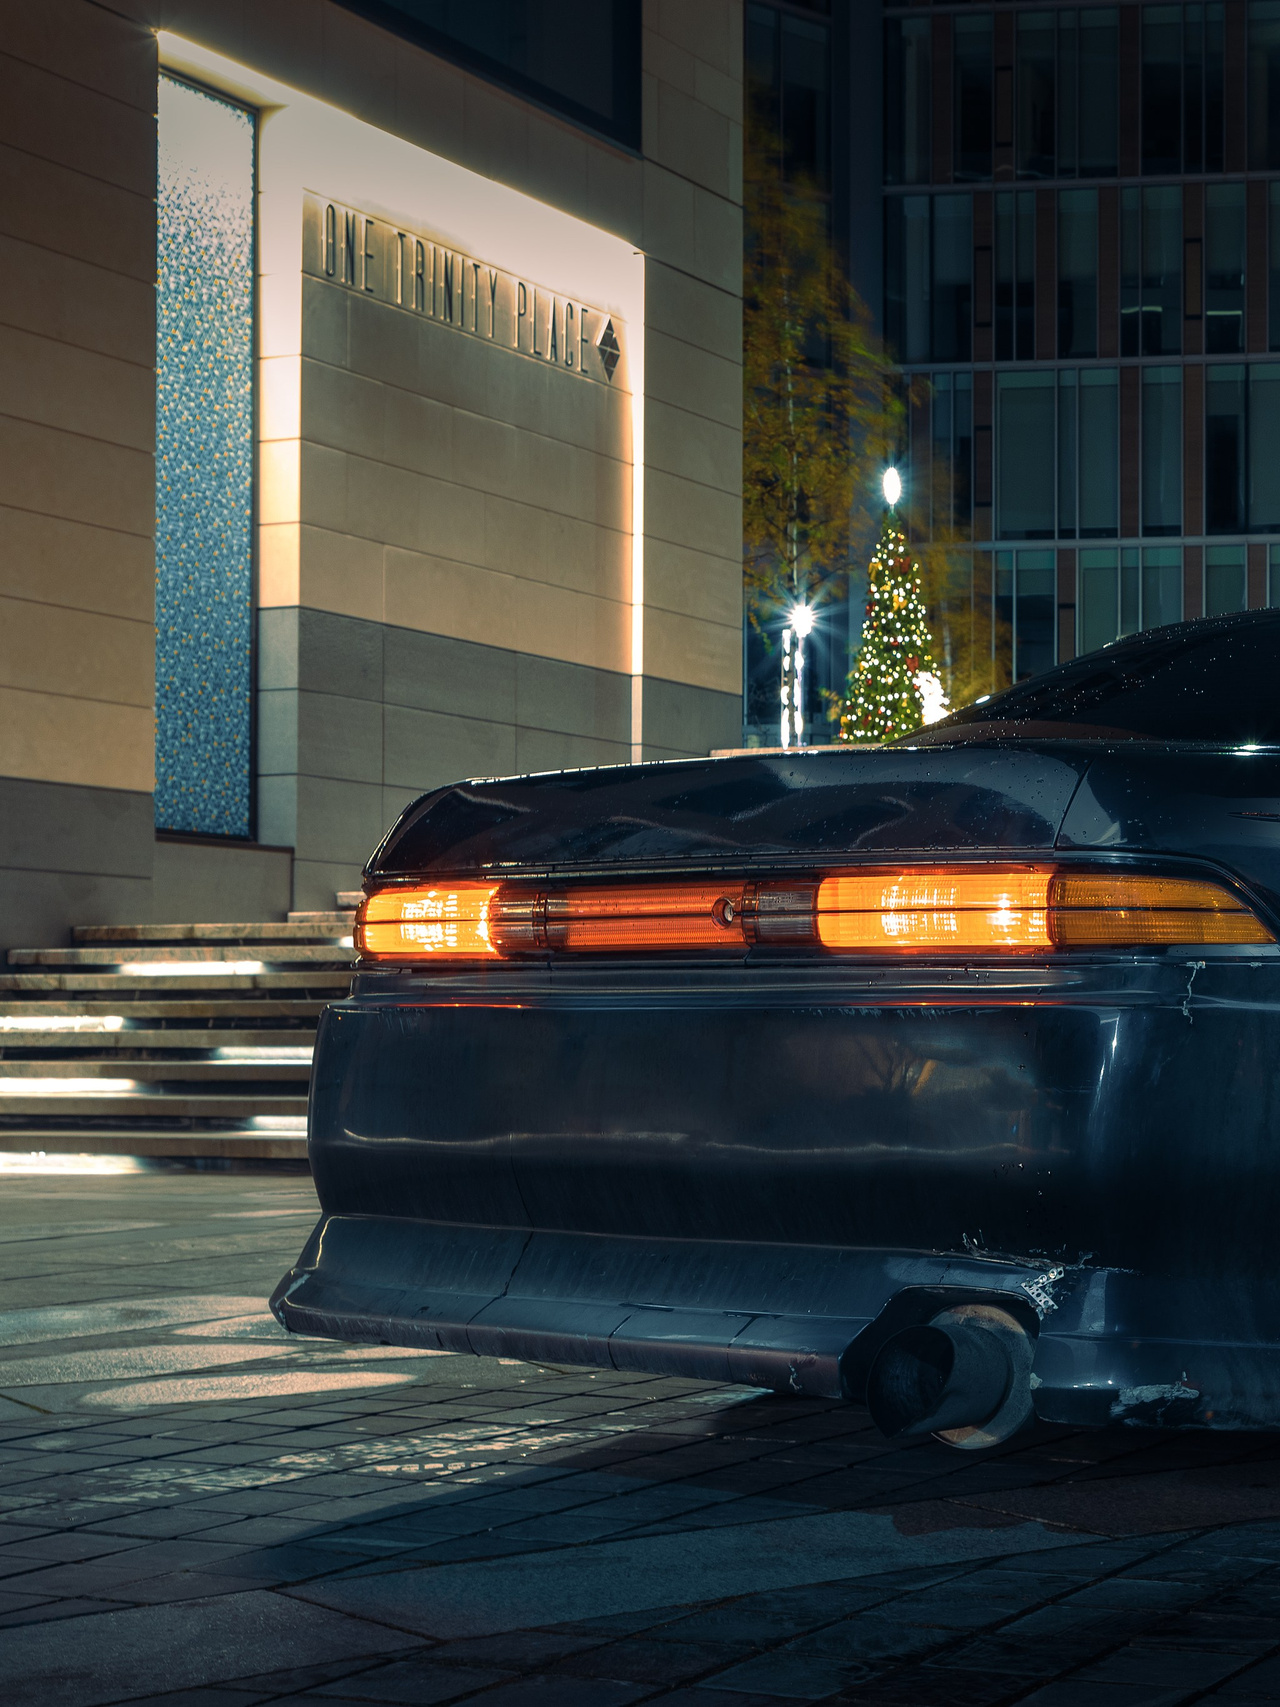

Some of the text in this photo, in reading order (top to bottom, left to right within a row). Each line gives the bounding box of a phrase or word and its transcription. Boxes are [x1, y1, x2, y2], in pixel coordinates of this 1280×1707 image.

[325, 203, 589, 375] ONE TRINITY PLACE
